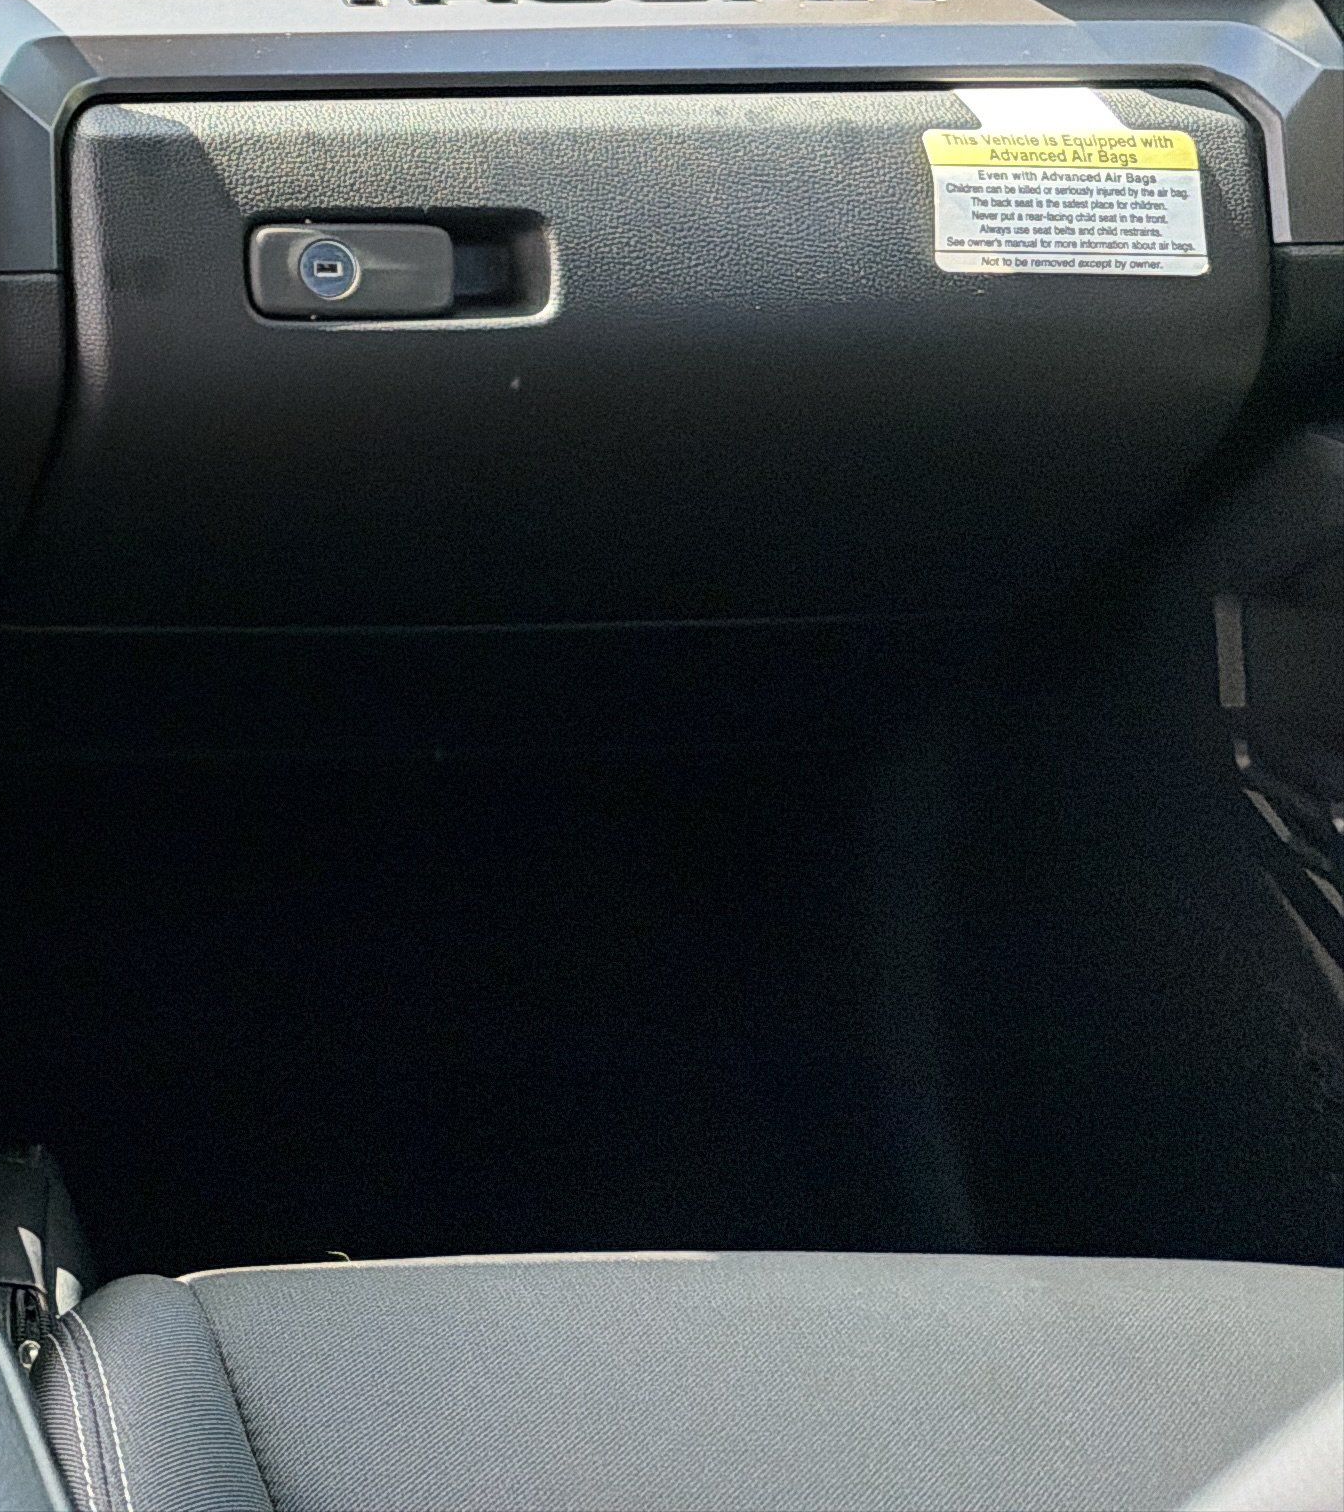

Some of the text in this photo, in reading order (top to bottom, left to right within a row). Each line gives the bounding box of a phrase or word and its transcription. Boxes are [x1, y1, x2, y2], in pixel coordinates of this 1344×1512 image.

[942, 133, 979, 147] This
[981, 134, 1040, 147] Vehicle
[1061, 135, 1137, 150] Equipped
[1140, 135, 1174, 149] with
[989, 149, 1138, 167] Advanced Air Bags
[977, 170, 1157, 186] Even with Advanced Air Bags
[946, 182, 984, 194] Children
[985, 185, 1002, 194] can
[1004, 184, 1016, 194] be
[1043, 186, 1052, 195] or
[1055, 187, 1094, 198] seriously
[1096, 187, 1126, 198] injured
[1128, 187, 1138, 199] by
[1141, 187, 1155, 198] the
[1157, 187, 1168, 198] air
[1170, 188, 1189, 200] bag.
[970, 196, 989, 207] The
[991, 197, 1013, 208] back
[1014, 198, 1034, 208] seat
[1036, 198, 1043, 208] is
[1045, 198, 1060, 208] the
[1090, 199, 1115, 211] place
[1116, 200, 1128, 210] for
[1130, 200, 1168, 211] children.
[971, 210, 1169, 224] Never put a rear-facing child seat in the front.
[979, 224, 1163, 237] Always use seat belts and child restraints.
[946, 236, 1196, 252] See owner's manual for more information about air bags.
[981, 256, 1164, 271] Not to be removed except by owner.
